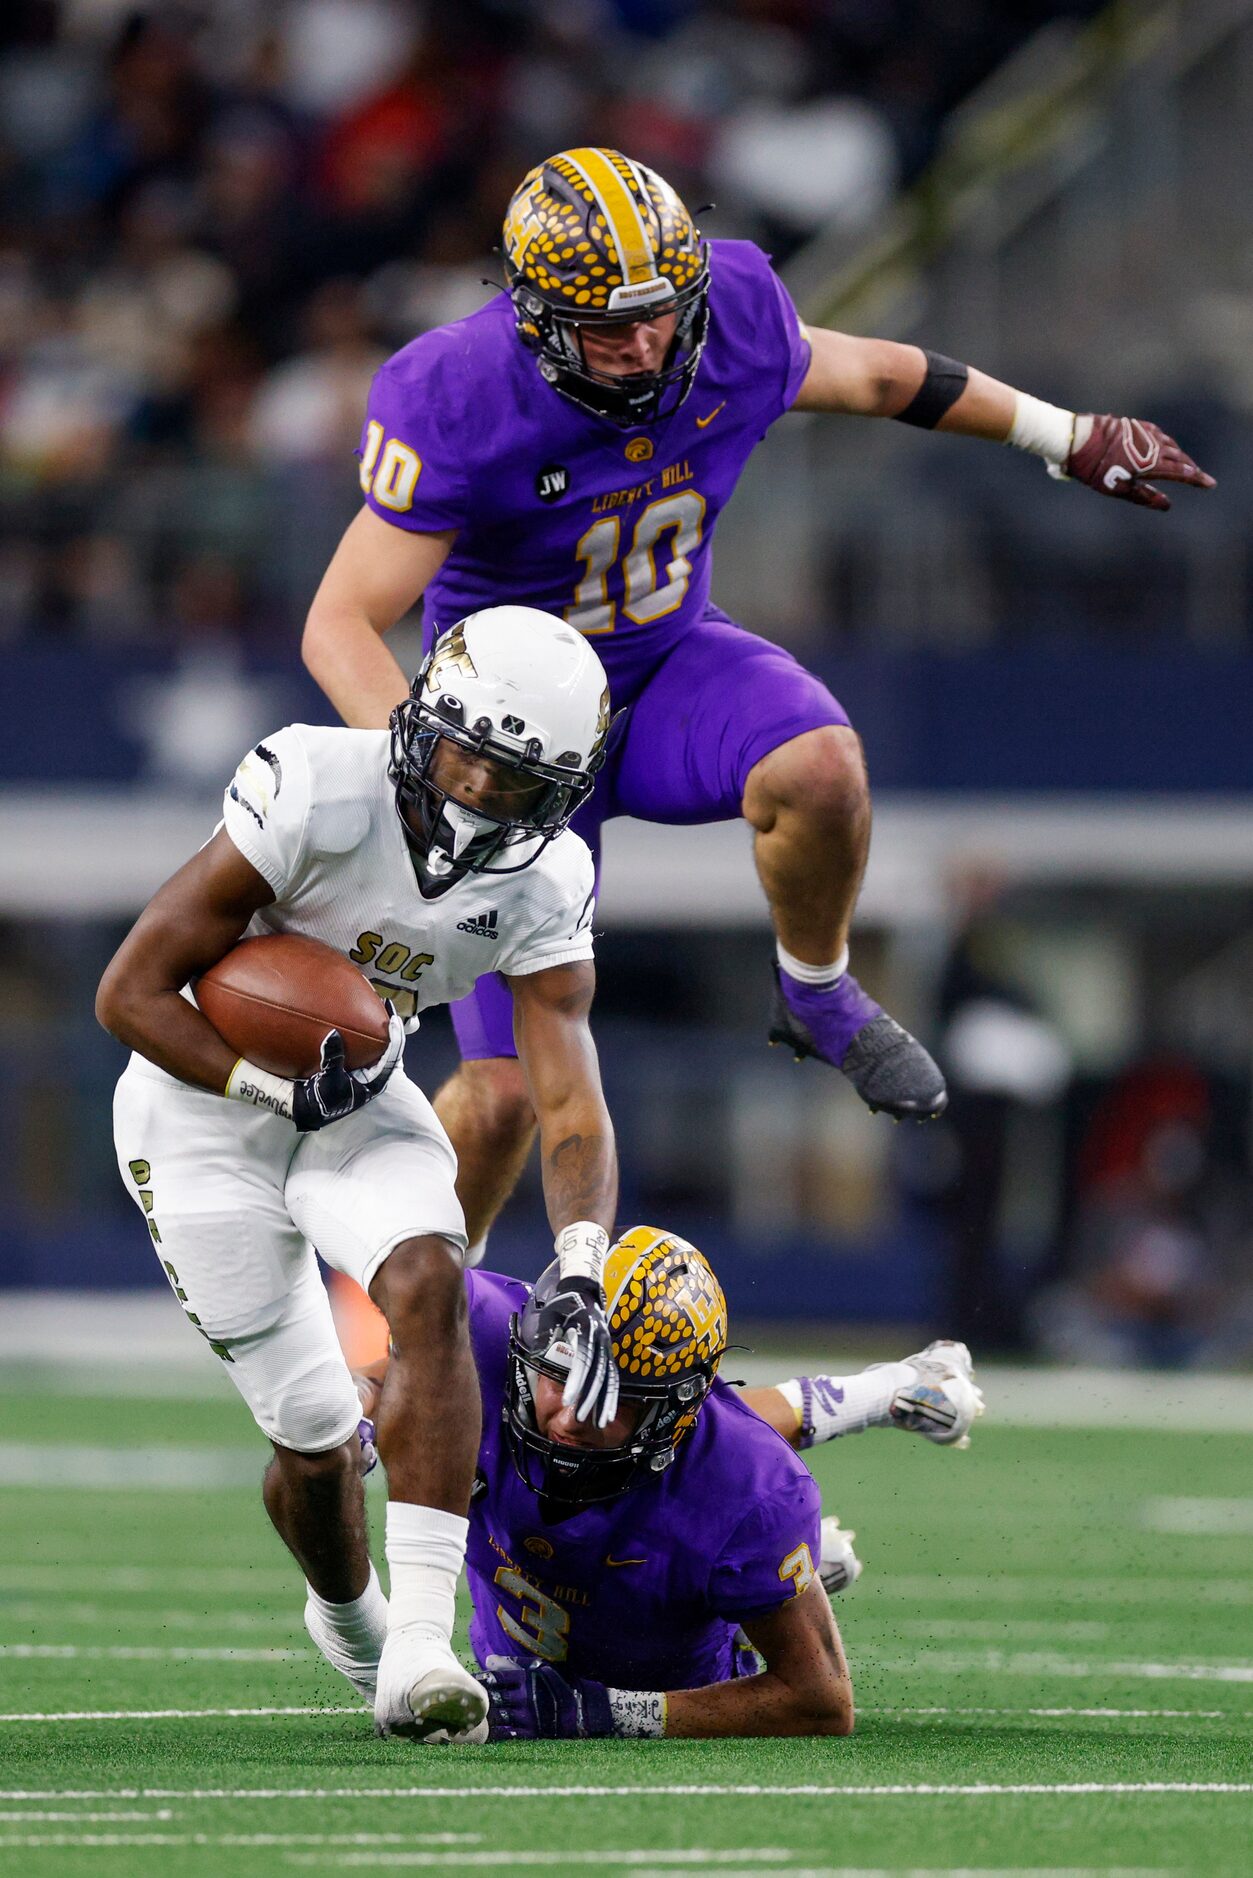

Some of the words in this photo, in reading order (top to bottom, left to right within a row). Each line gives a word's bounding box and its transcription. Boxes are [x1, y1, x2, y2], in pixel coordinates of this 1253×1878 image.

[359, 419, 423, 513] 10
[540, 470, 566, 496] JW
[662, 459, 694, 489] HILL
[563, 488, 706, 635] 10
[349, 930, 435, 982] SOC
[456, 921, 499, 940] adidas
[494, 1566, 570, 1663] 3
